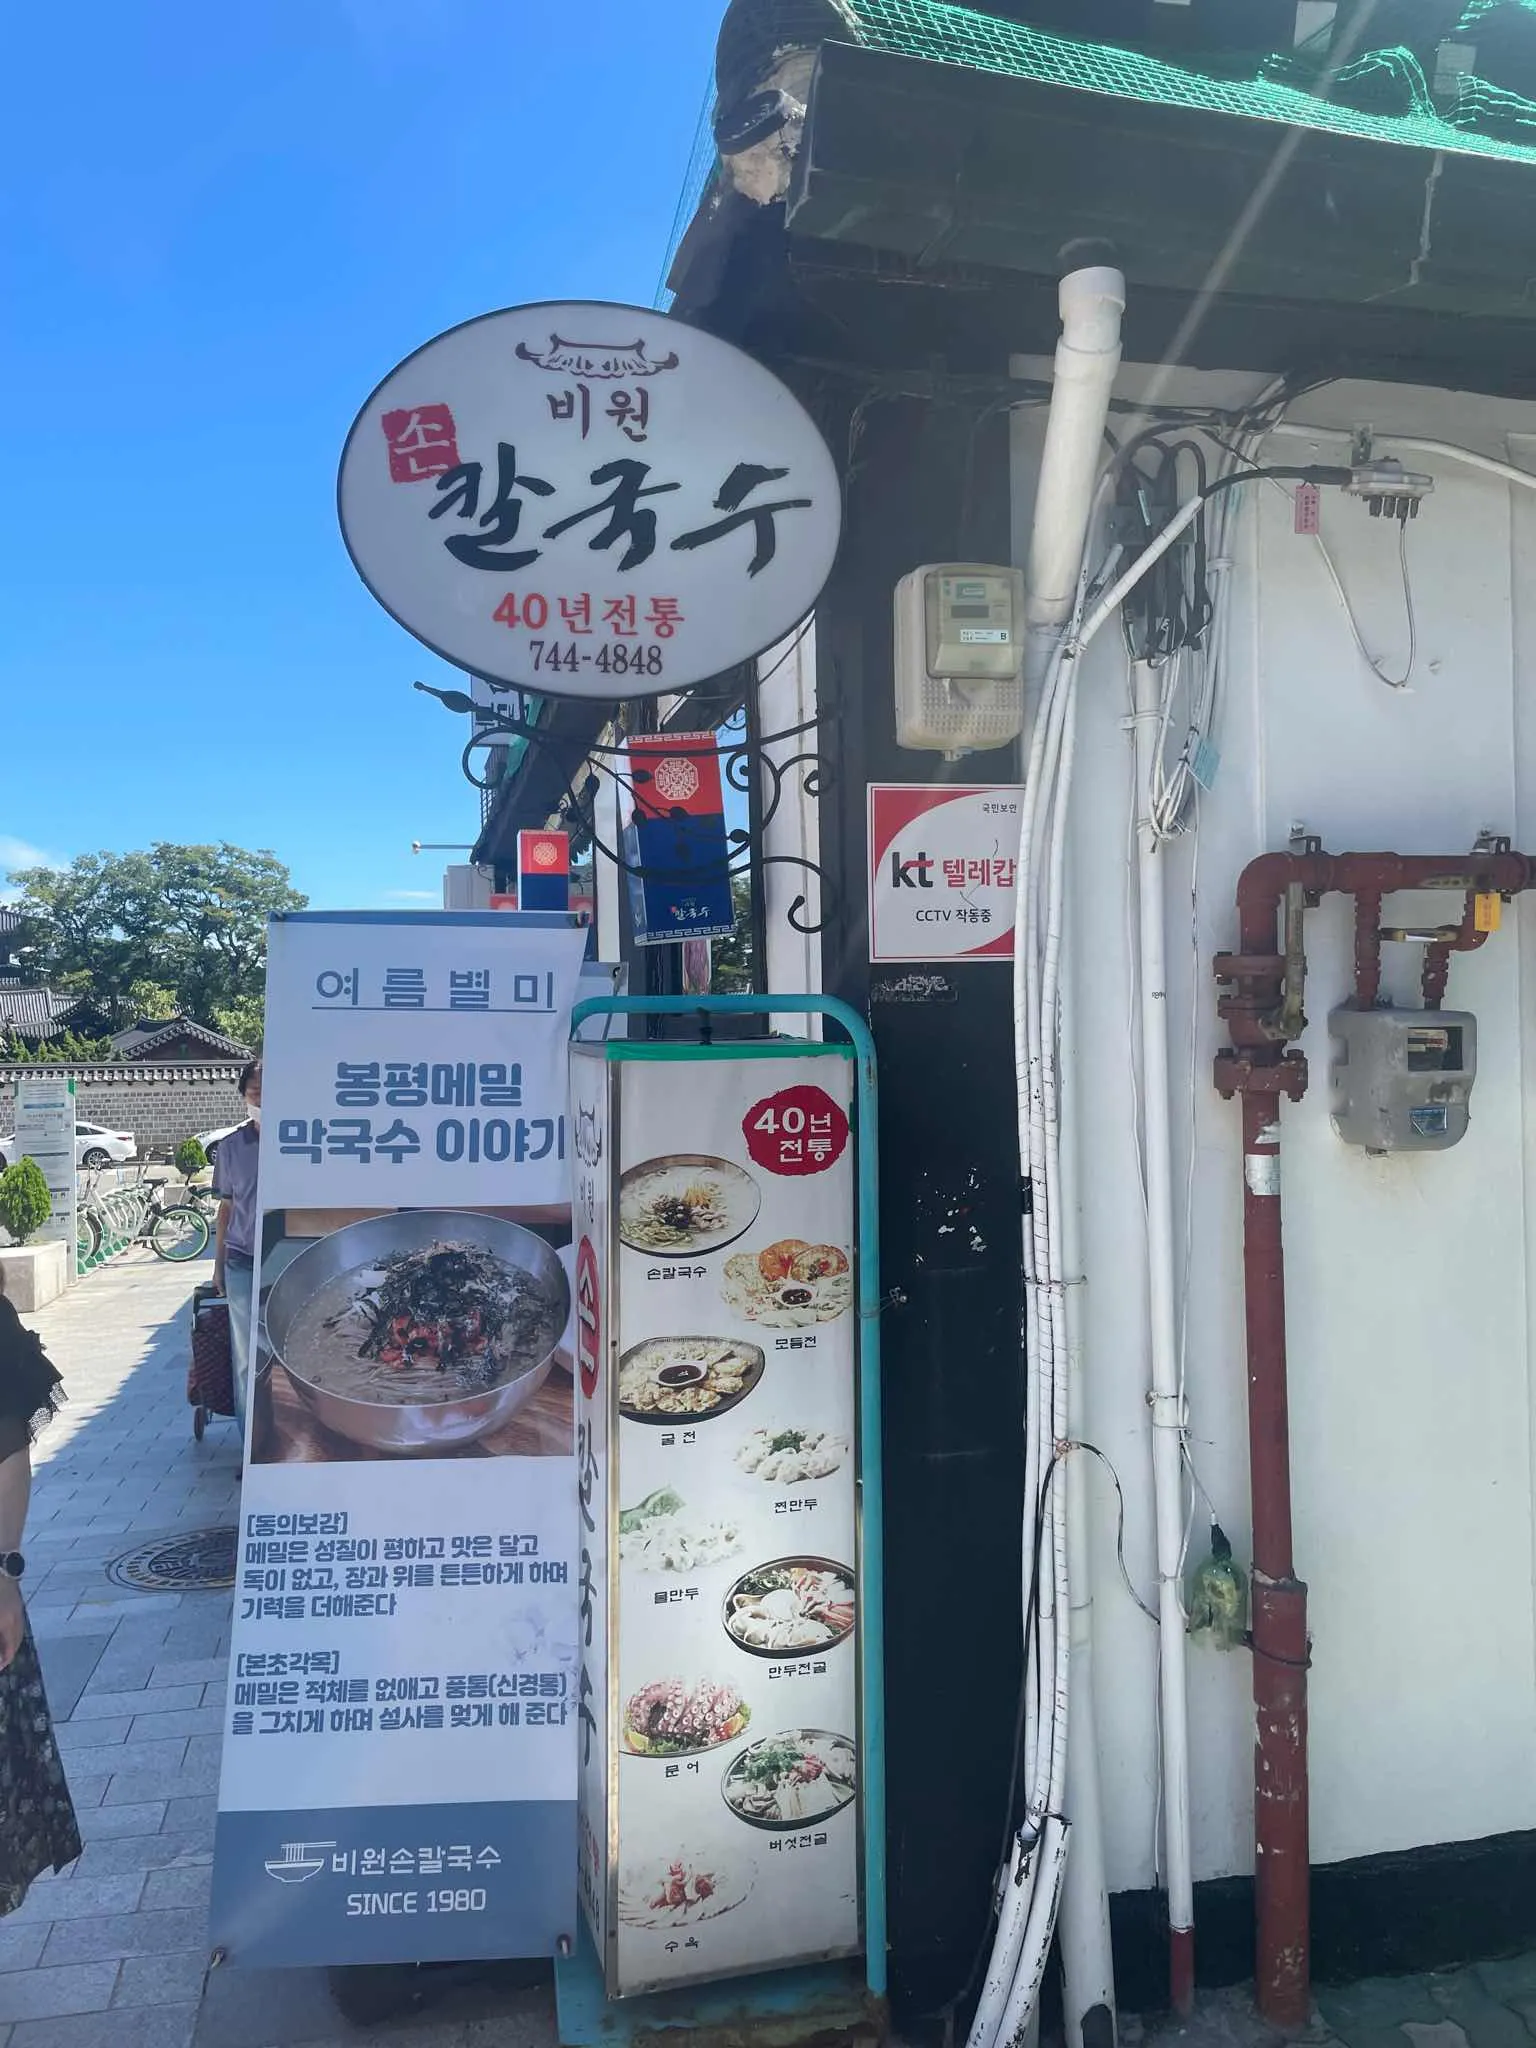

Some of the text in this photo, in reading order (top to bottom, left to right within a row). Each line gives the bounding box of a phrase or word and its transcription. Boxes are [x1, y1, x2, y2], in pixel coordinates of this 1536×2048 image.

[546, 383, 649, 442] 비원
[396, 412, 812, 578] 손 칼국수
[530, 640, 663, 676] 744-4848
[892, 852, 1016, 888] kt 텔레캅
[916, 908, 992, 923] CCTV 작동중
[335, 1061, 522, 1107] 봉평메밀
[754, 1106, 832, 1134] 40년
[278, 1115, 565, 1164] 막국수 이야기
[780, 1138, 833, 1163] 전통
[647, 1265, 707, 1281] 손칼국수
[775, 1336, 817, 1350] 모듬전
[774, 1498, 818, 1514] 찐만두
[247, 1512, 348, 1537] [동의보감]
[245, 1534, 538, 1564] 메밀은 성질이 평하고 맛은 달고
[243, 1561, 568, 1592] 독이 없고, 장과 위를 든든하게 하며
[241, 1593, 397, 1620] 기력을 더해준다
[653, 1588, 700, 1605] 물만두
[768, 1661, 827, 1679] 만두전골
[234, 1680, 299, 1705] 메밀은
[305, 1679, 368, 1703] 적체를
[376, 1677, 439, 1701] 없애고
[232, 1711, 253, 1735] 을
[259, 1709, 325, 1734] 그치게
[330, 1708, 373, 1732] 하며
[379, 1705, 443, 1730] 설사를
[498, 1702, 519, 1725] 해
[525, 1702, 568, 1726] 준다
[769, 1833, 828, 1851] 버섯전골
[331, 1844, 502, 1876] 비원손칼국수
[347, 1888, 487, 1916] SINCE 1980
